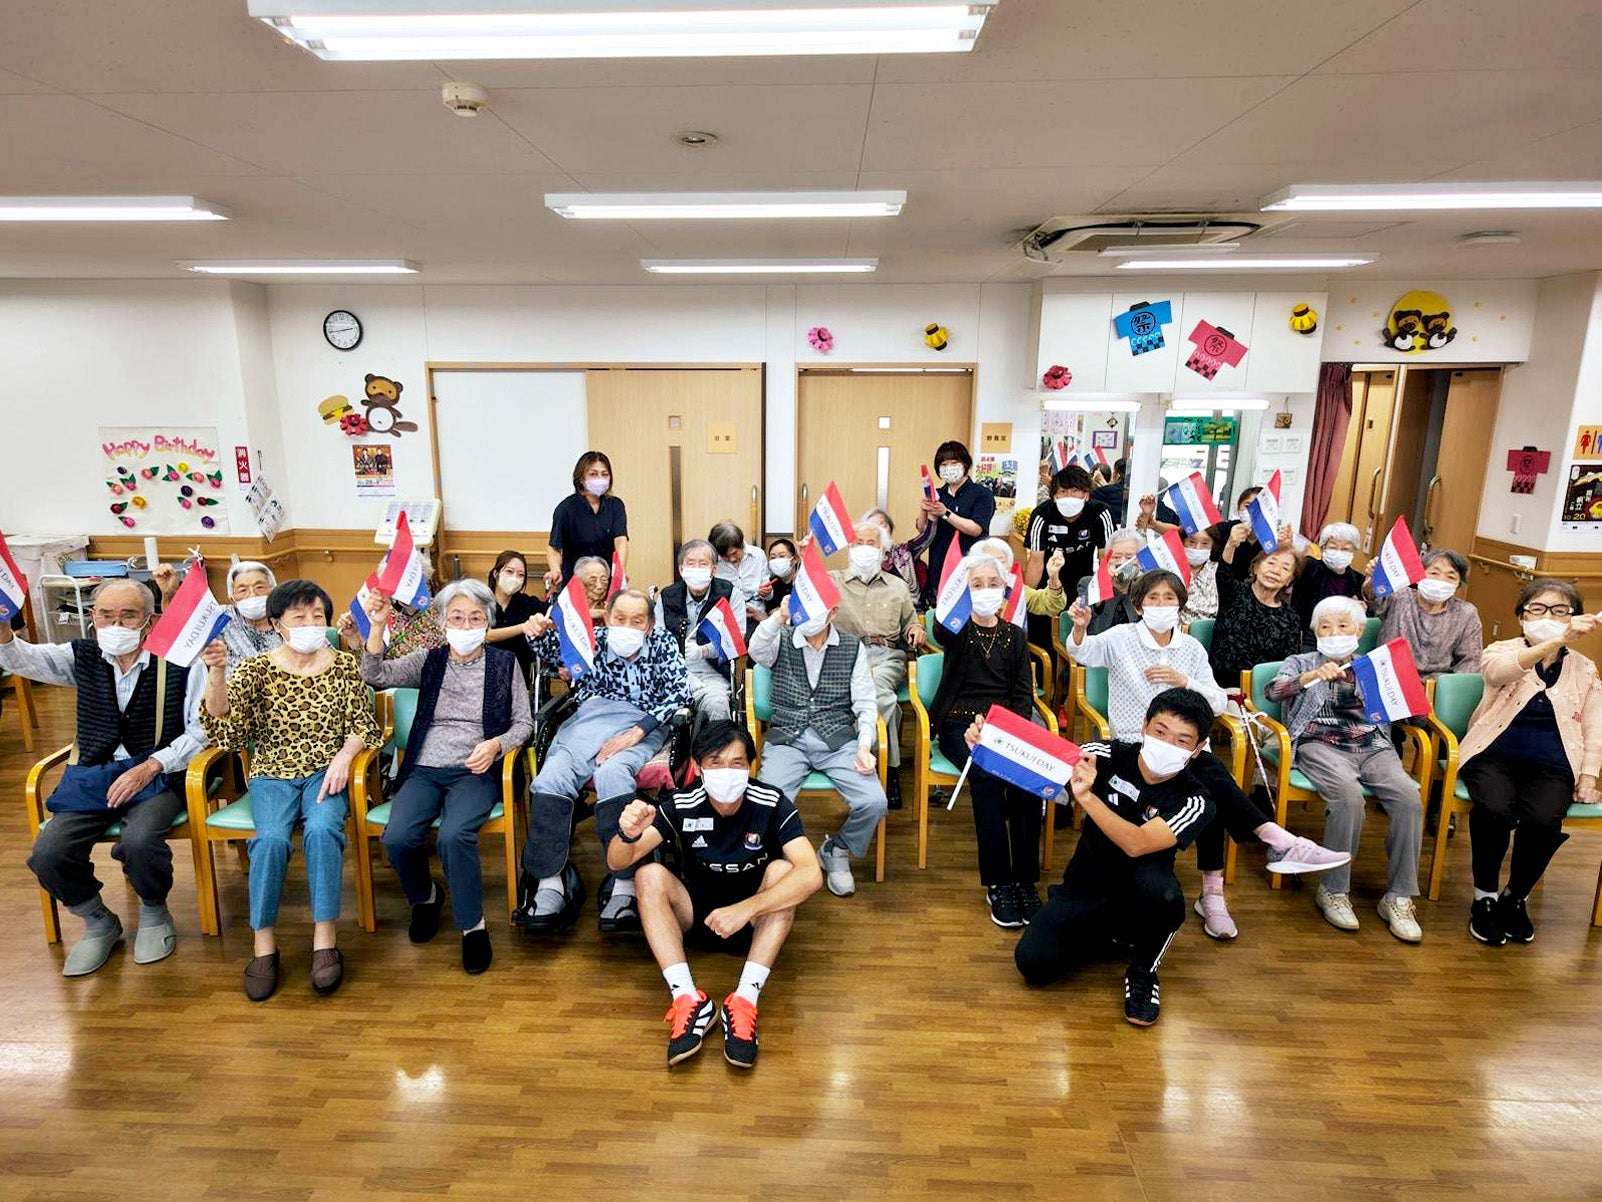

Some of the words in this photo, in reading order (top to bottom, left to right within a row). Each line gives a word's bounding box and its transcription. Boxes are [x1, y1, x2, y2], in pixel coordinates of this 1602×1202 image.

[1134, 313, 1151, 332] 祭
[1210, 336, 1224, 353] 祭
[102, 440, 150, 460] Happy
[154, 434, 215, 464] Birthday
